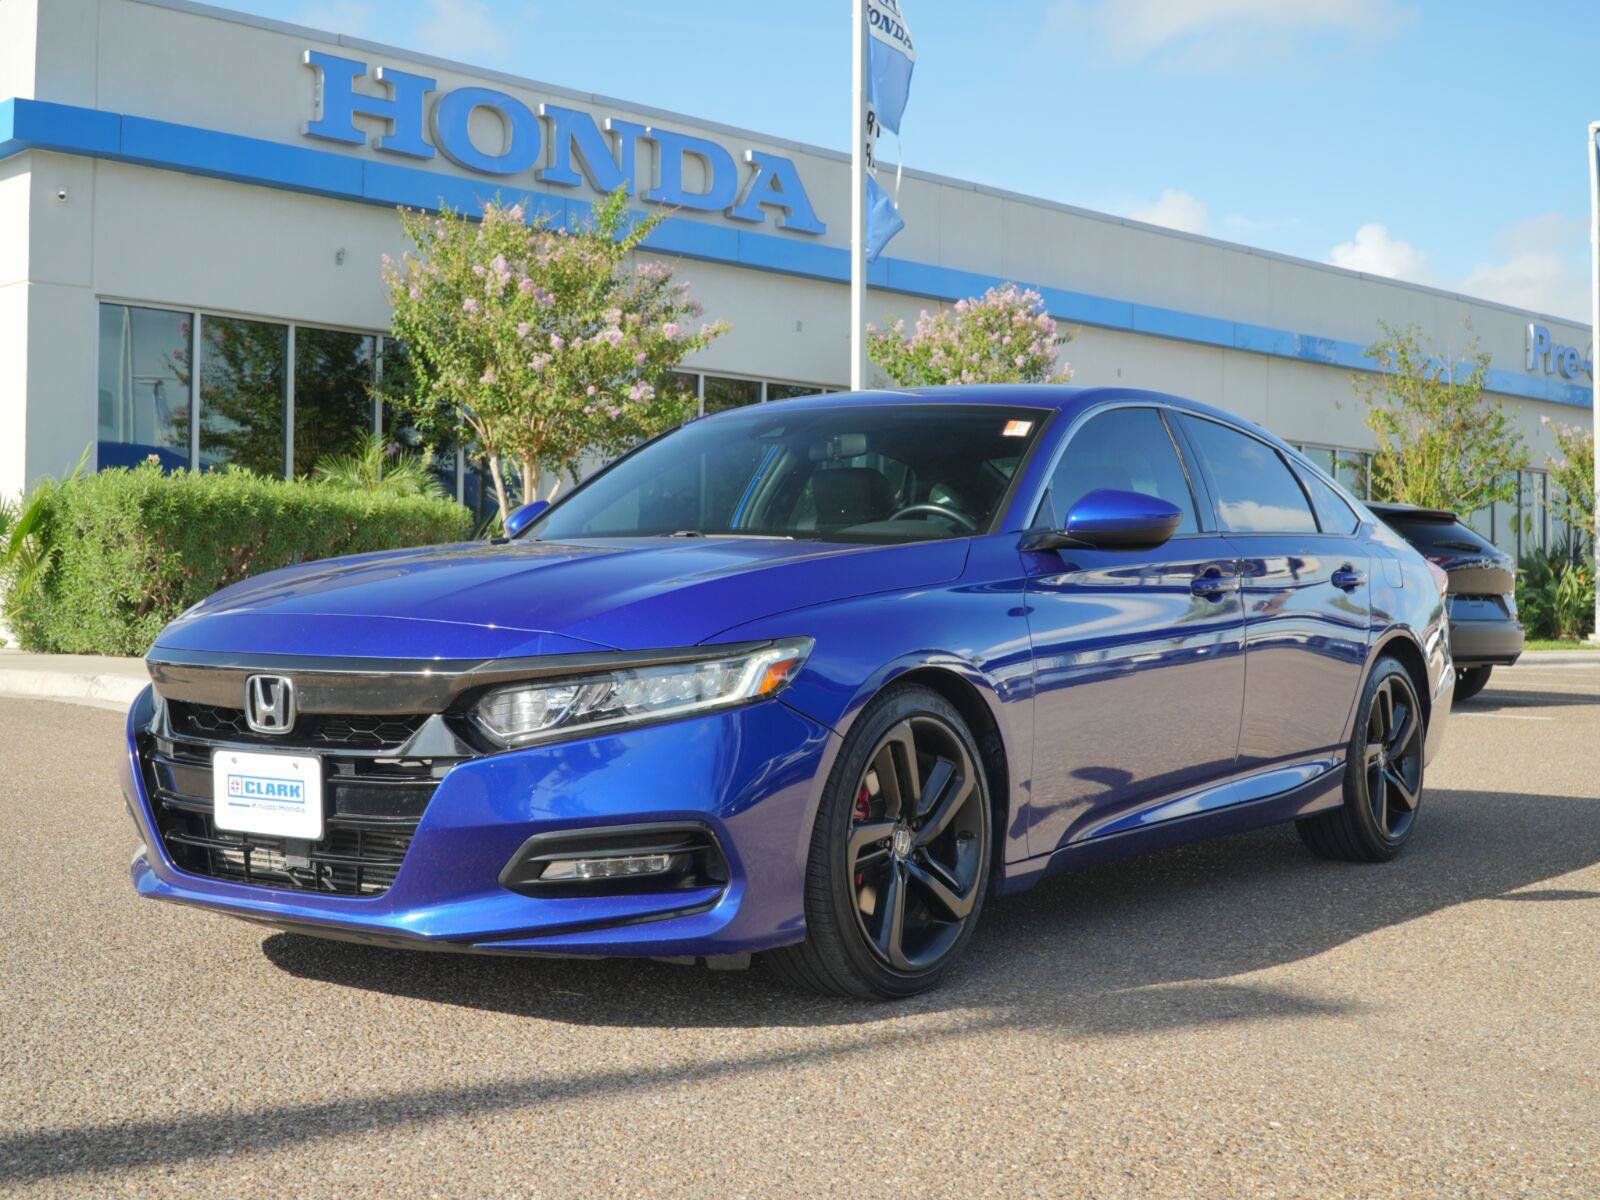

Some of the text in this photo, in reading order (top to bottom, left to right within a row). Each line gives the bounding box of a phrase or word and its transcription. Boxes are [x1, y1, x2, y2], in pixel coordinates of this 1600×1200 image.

[303, 49, 826, 236] HONDA
[1525, 323, 1593, 380] Pre-
[245, 781, 301, 798] CLARK
[278, 804, 305, 813] Honda
